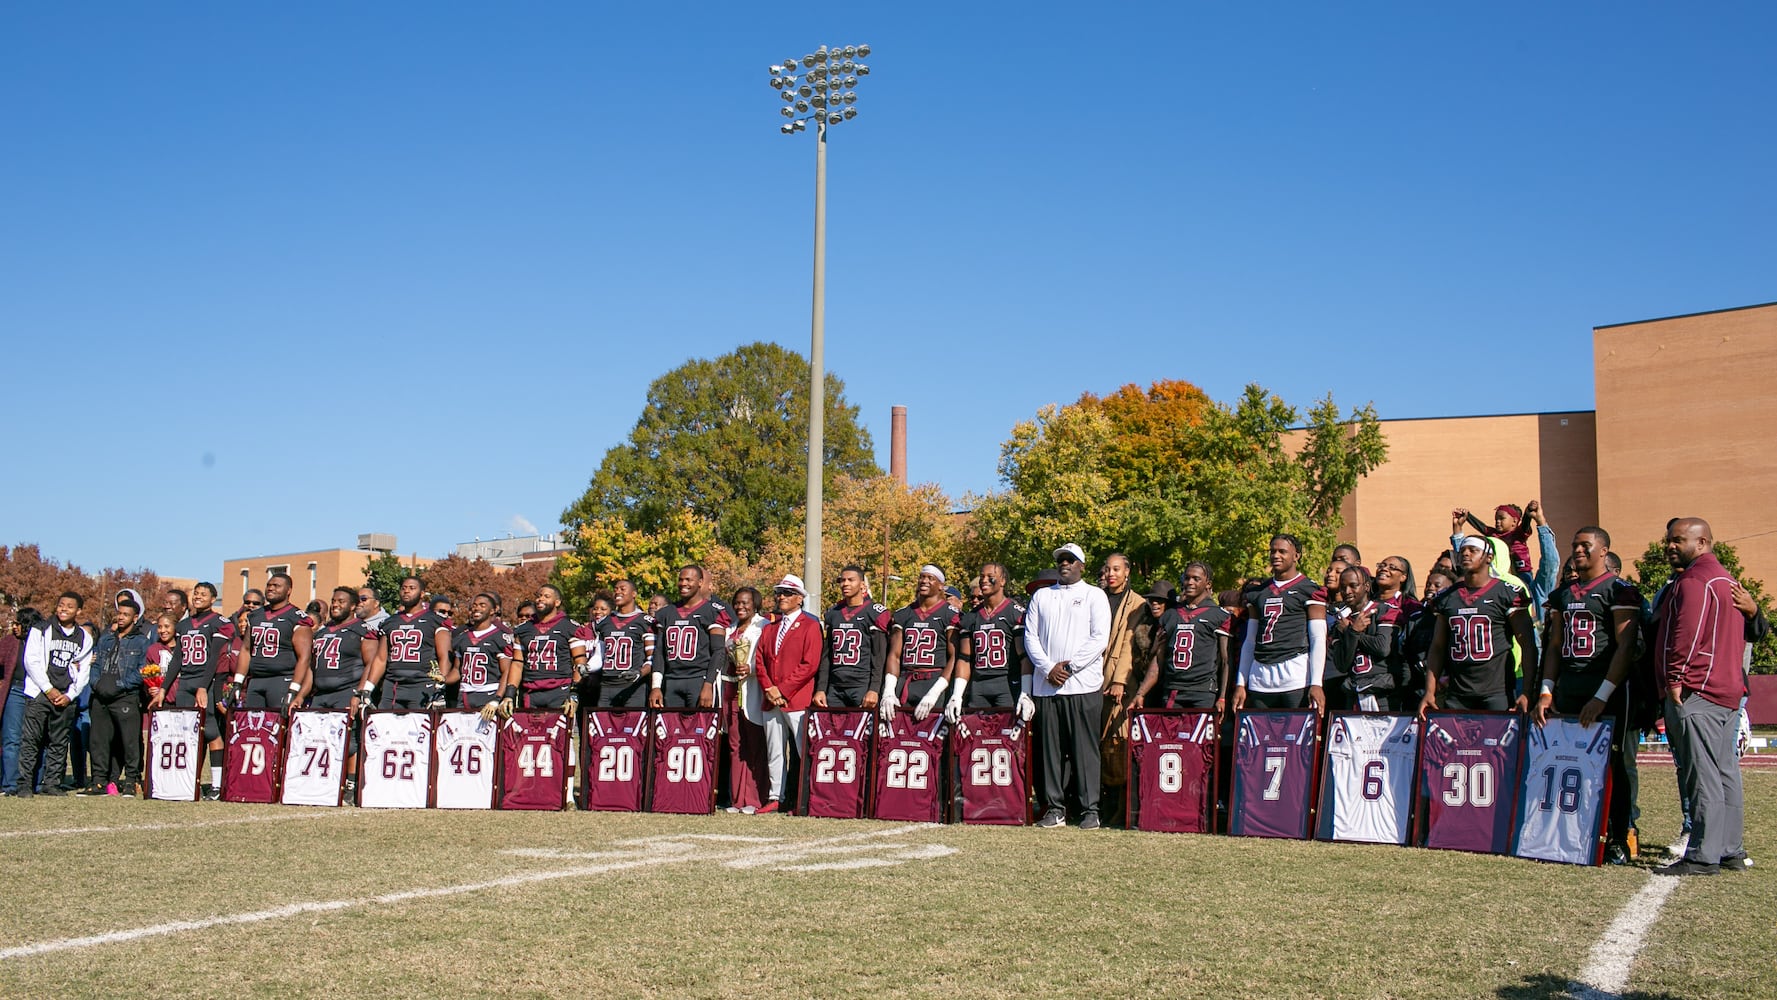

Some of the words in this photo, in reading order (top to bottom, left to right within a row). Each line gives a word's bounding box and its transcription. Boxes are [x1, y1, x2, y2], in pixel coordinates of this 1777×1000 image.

[1262, 603, 1284, 644] 7
[1449, 615, 1494, 661] 30
[1562, 610, 1596, 657] 18
[181, 634, 207, 665] 88
[252, 626, 280, 658] 79
[313, 637, 342, 669] 74
[390, 629, 423, 662] 62
[527, 639, 557, 671] 44
[603, 637, 633, 670] 20
[666, 626, 698, 661] 90
[832, 628, 862, 665] 23
[903, 627, 937, 665] 22
[973, 629, 1006, 669] 28
[1173, 630, 1194, 670] 8
[462, 652, 488, 686] 46
[368, 729, 378, 740] 6
[417, 732, 426, 744] 2
[1131, 723, 1141, 741] 8
[1335, 728, 1344, 743] 6
[1596, 737, 1609, 755] 8
[161, 742, 187, 769] 88
[240, 743, 266, 775] 79
[301, 747, 330, 777] 74
[382, 749, 415, 780] 62
[449, 744, 482, 775] 46
[517, 744, 553, 777] 44
[598, 745, 634, 782] 20
[666, 746, 703, 783] 90
[815, 747, 857, 784] 23
[886, 748, 929, 790] 22
[971, 748, 1012, 786] 28
[1158, 752, 1182, 793] 8
[1263, 756, 1287, 801] 7
[1360, 759, 1385, 802] 6
[1442, 762, 1495, 808] 30
[1538, 764, 1582, 815] 18
